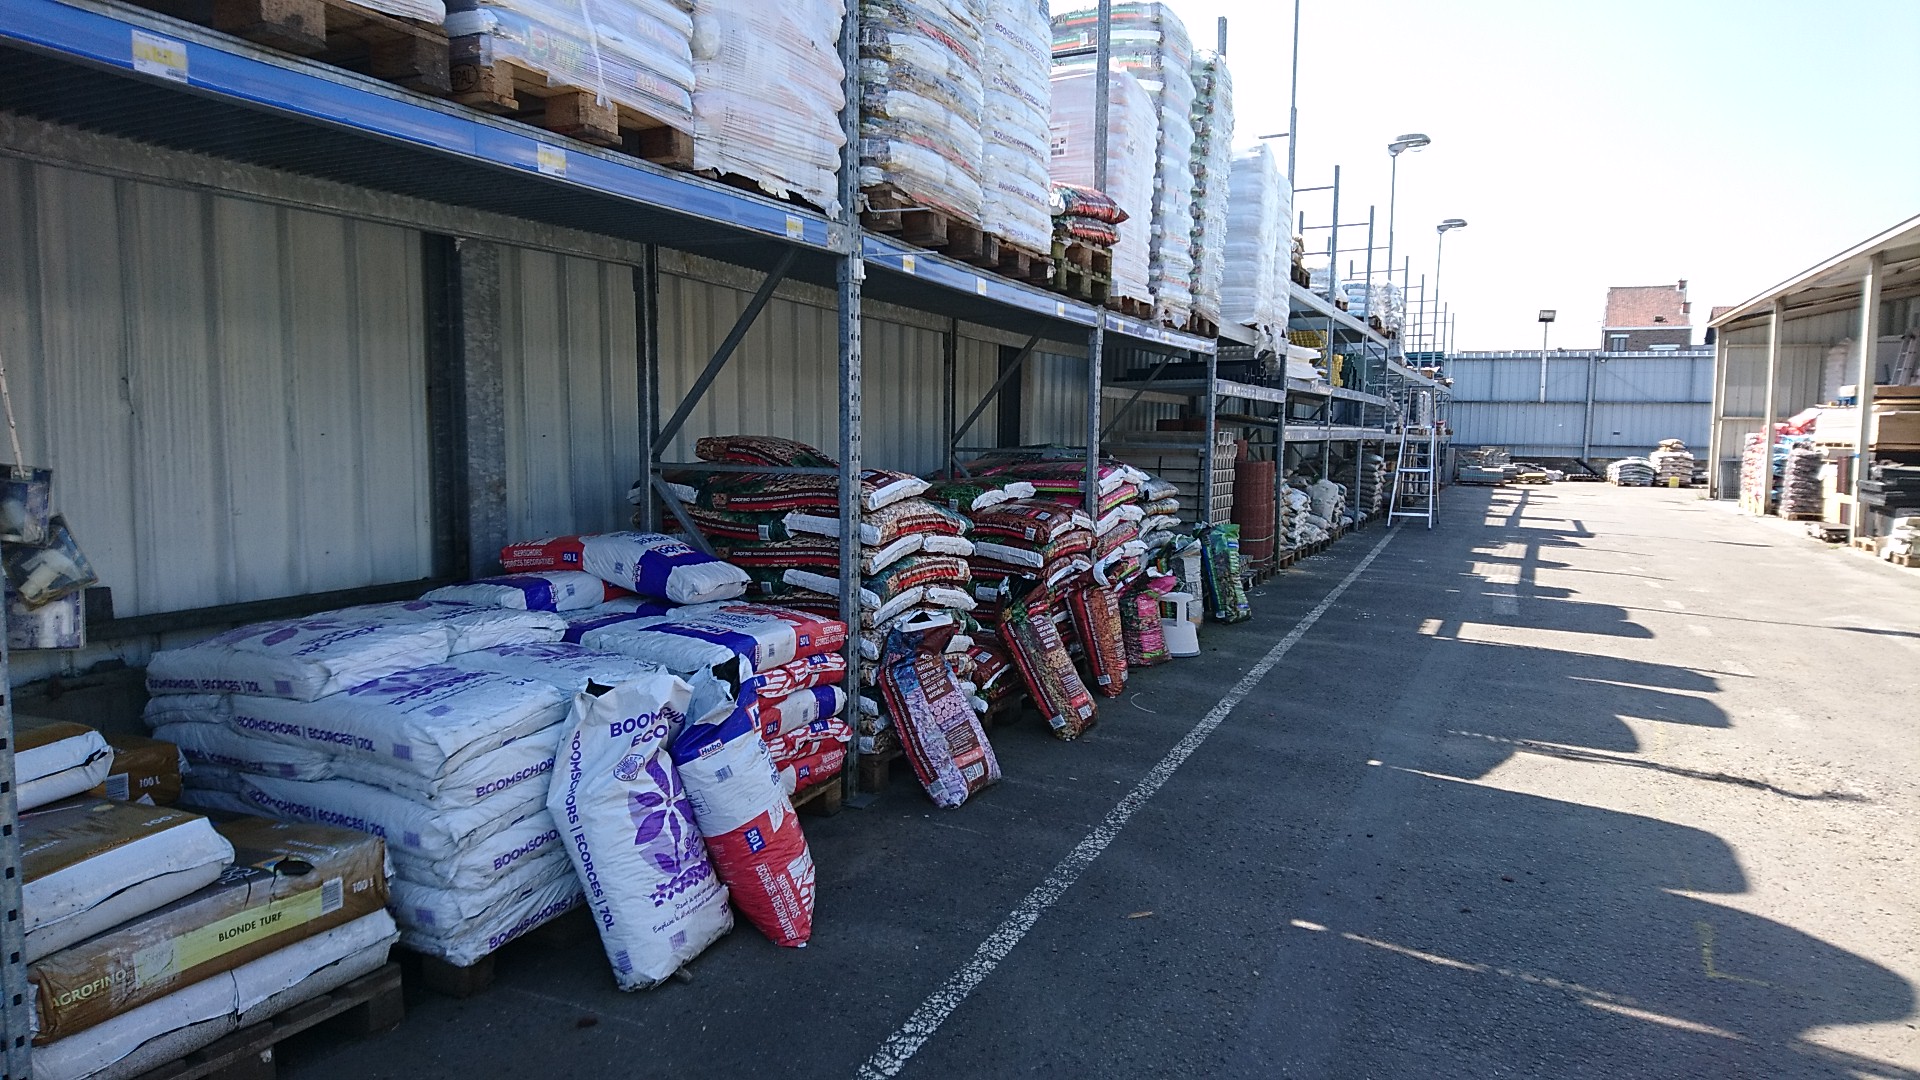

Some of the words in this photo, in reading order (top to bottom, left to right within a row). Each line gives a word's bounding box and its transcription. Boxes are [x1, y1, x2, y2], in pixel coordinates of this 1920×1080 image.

[237, 715, 301, 738] BOOMSCHORS
[307, 727, 353, 747] ECORCES
[358, 738, 376, 752] 70L
[701, 742, 722, 756] Hubo
[476, 756, 556, 798] BOOMSCHOR
[493, 829, 561, 871] BOOMSCHO
[574, 832, 604, 900] ECORCES
[600, 906, 616, 932] 70L
[756, 863, 778, 897] ECORCES
[776, 874, 801, 919] SIERSCHORS
[218, 919, 257, 942] BLONDE
[260, 911, 283, 927] TURF
[52, 968, 127, 1009] AGROFINO
